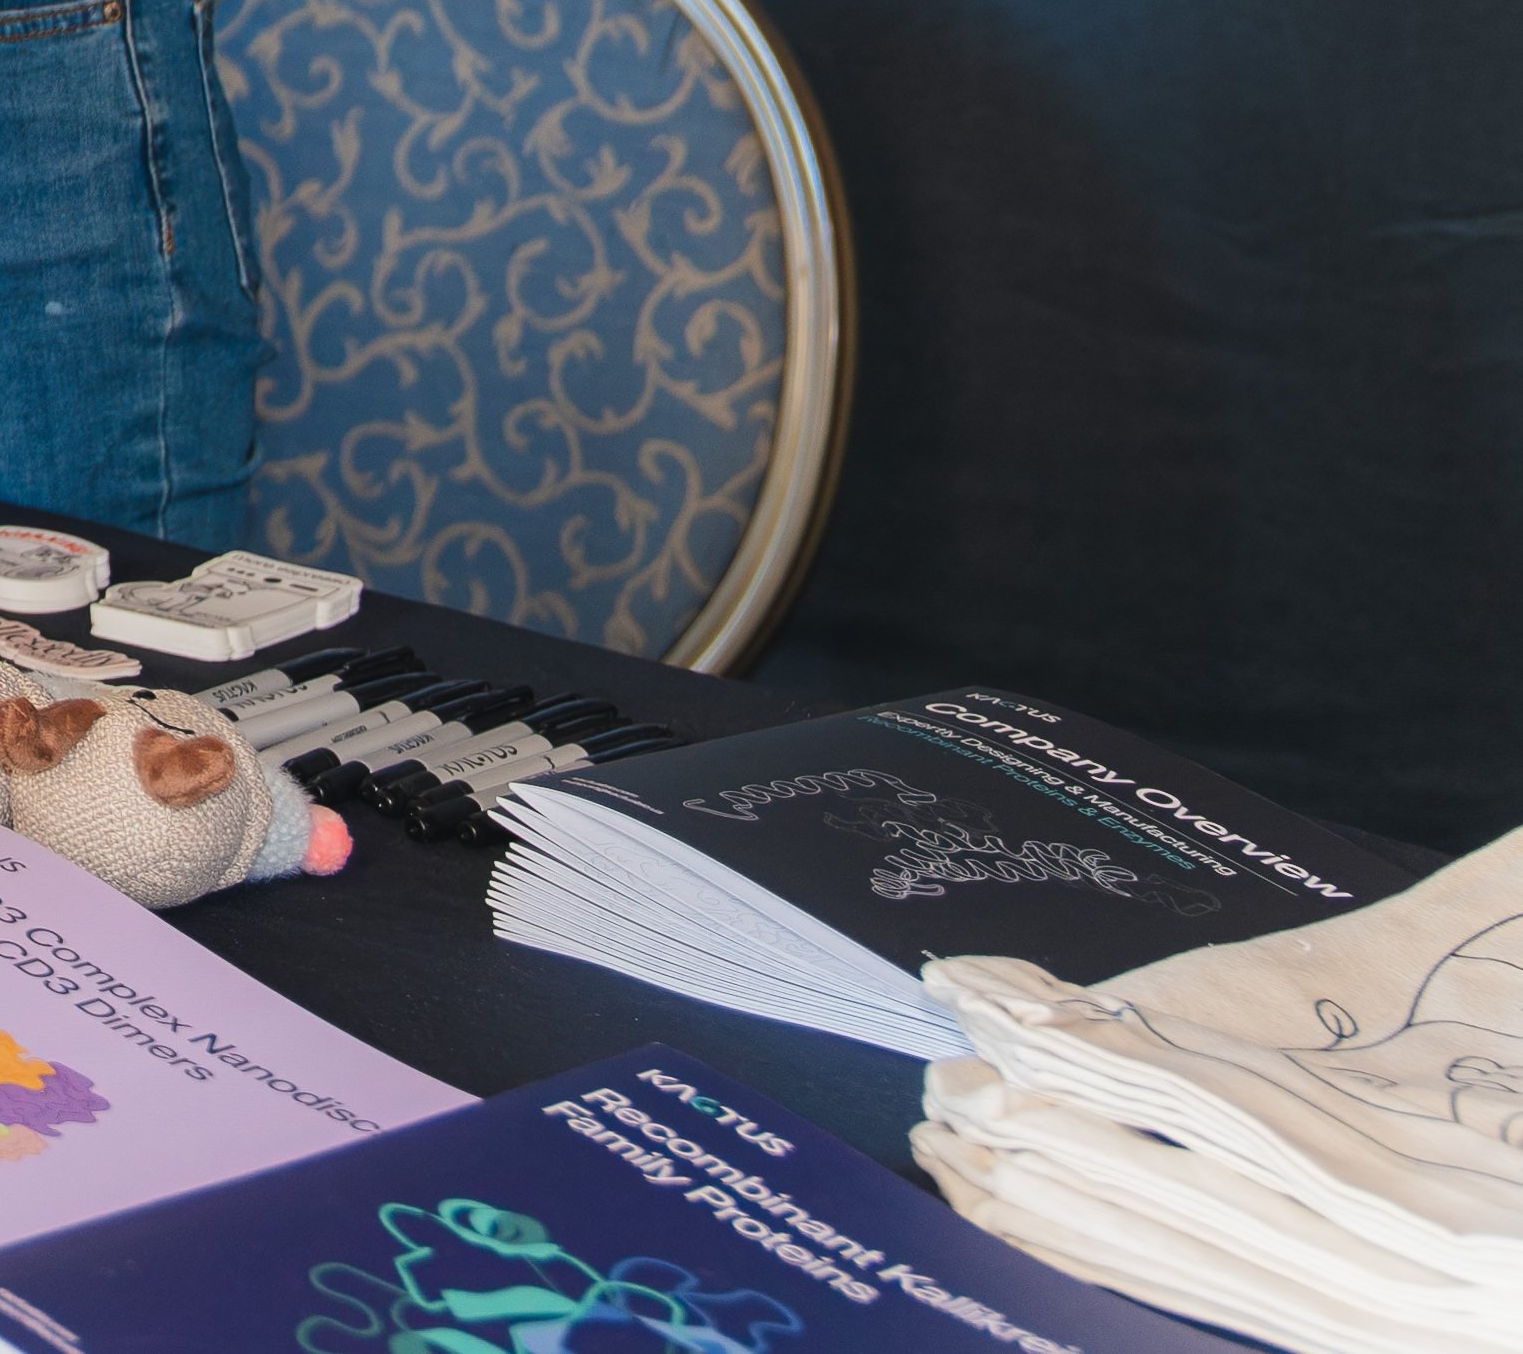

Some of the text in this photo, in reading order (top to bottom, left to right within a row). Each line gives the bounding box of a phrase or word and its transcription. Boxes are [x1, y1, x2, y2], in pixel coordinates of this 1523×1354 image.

[965, 691, 1062, 724] KACTUS
[855, 714, 1197, 872] Recombinant Proteins & Enzymes
[875, 710, 1238, 878] Expertly Designing & Manufacturing
[923, 700, 1355, 900] Company Overview
[23, 925, 195, 1035] Complex
[187, 1031, 383, 1136] Nanodisc
[73, 995, 219, 1084] Dimers
[634, 1067, 797, 1158] KACTUS
[540, 1099, 883, 1306] Family Proteins
[580, 1086, 886, 1270] Recombinant
